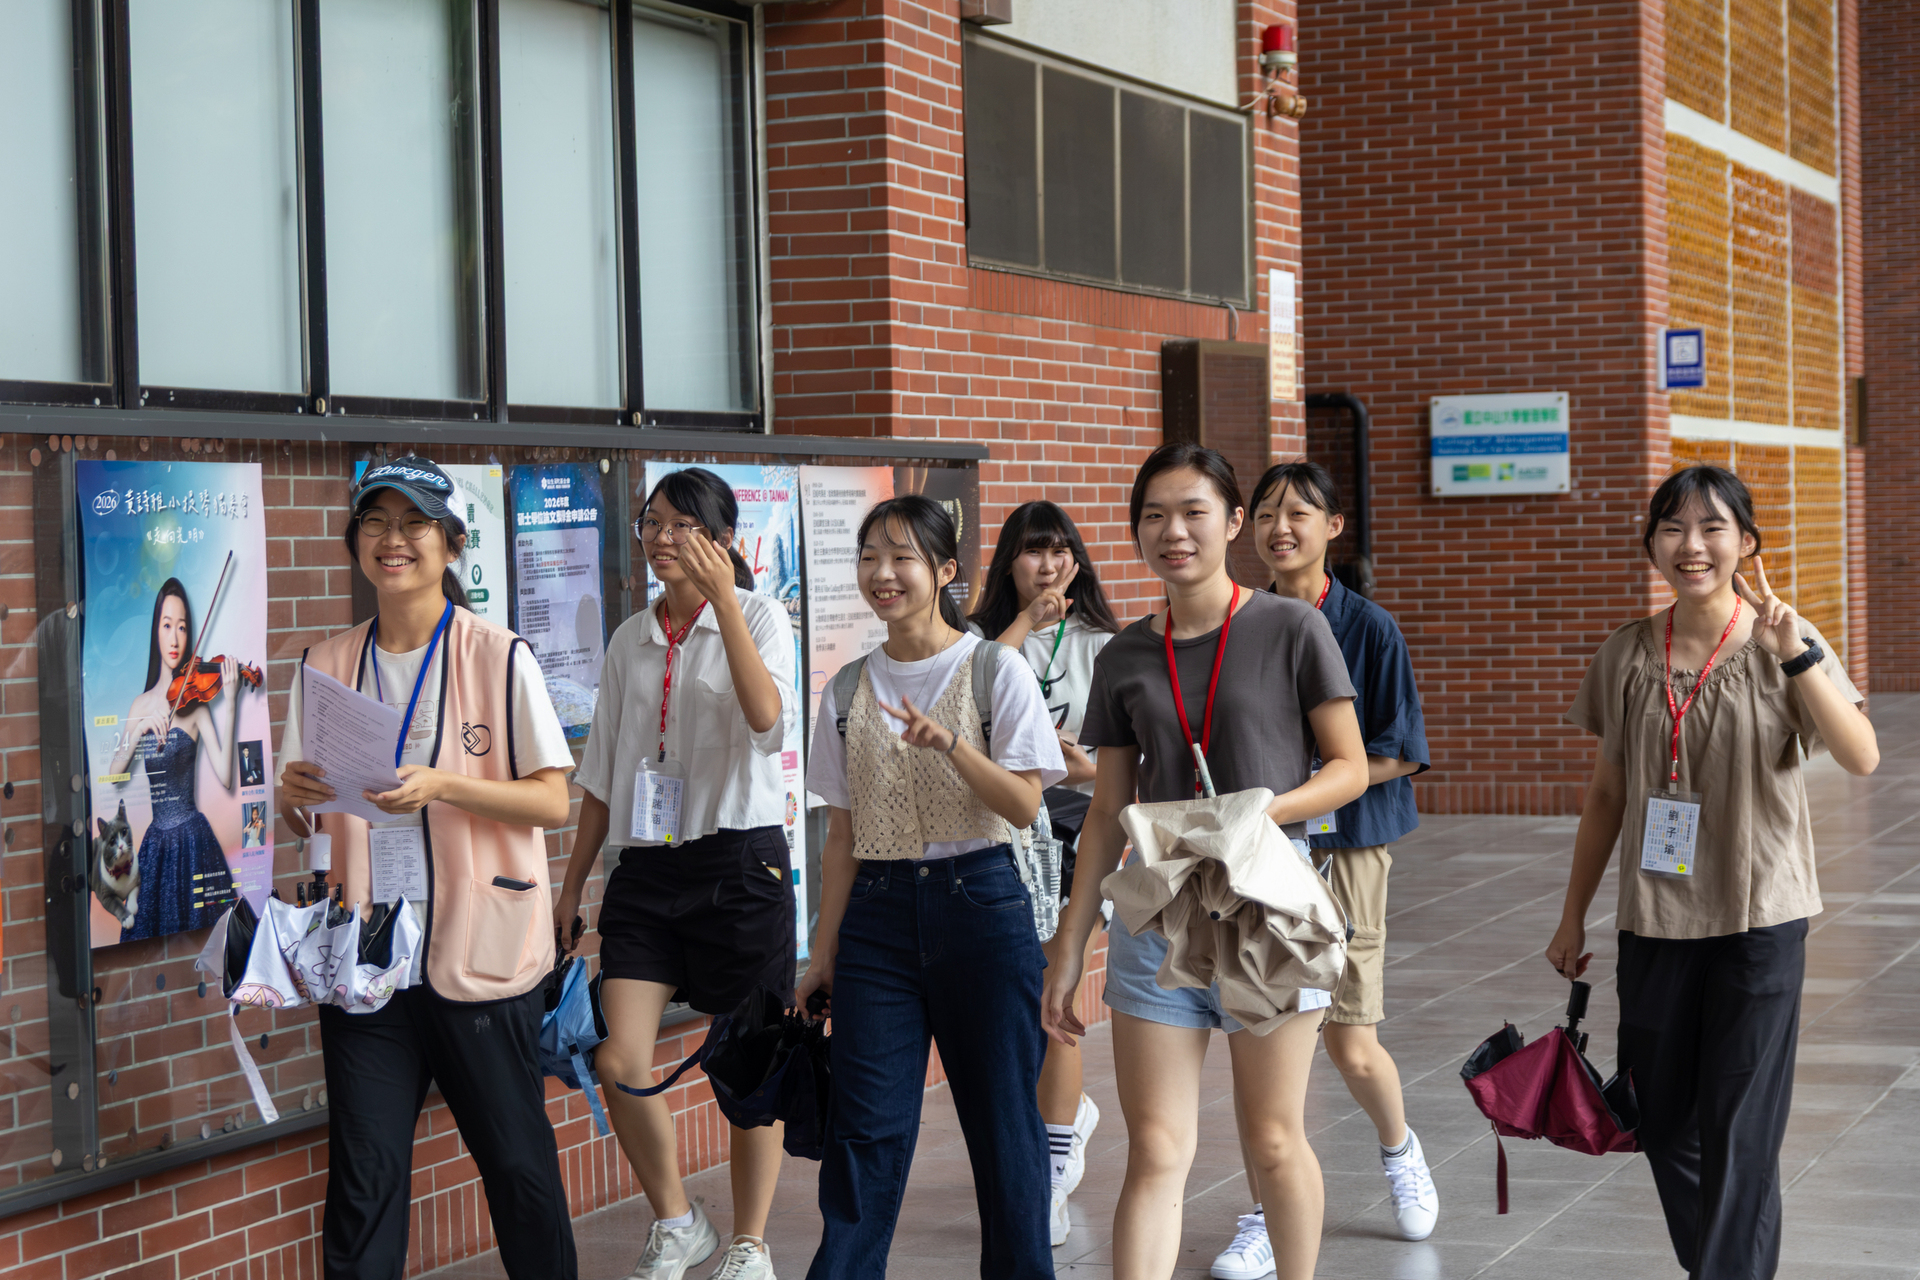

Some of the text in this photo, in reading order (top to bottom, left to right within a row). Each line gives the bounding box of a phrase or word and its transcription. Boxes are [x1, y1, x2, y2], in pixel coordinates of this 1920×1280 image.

[367, 465, 449, 489] Luxgen
[95, 495, 117, 509] 2026
[113, 730, 130, 752] 24
